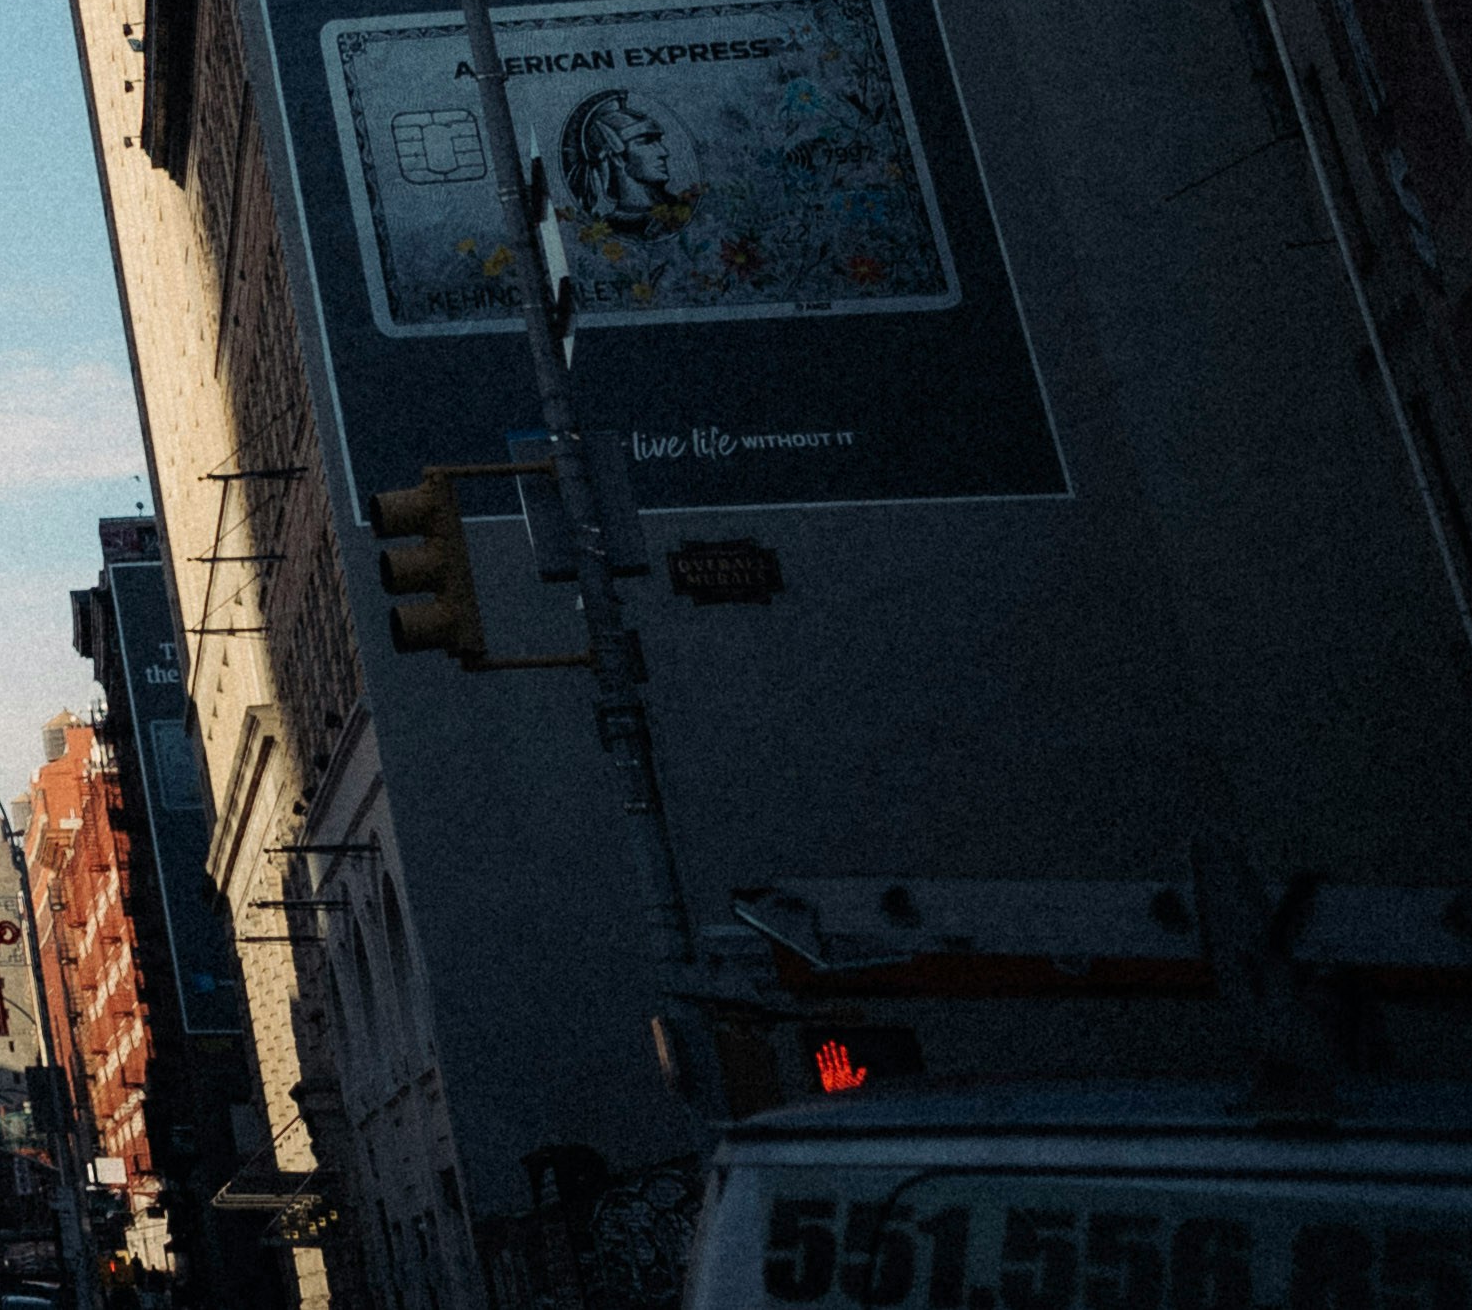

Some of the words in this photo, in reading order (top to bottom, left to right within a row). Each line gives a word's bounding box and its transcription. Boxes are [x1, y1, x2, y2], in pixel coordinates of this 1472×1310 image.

[454, 48, 615, 80] AERICAN
[623, 38, 770, 70] EXPRESS
[632, 430, 686, 462] live
[691, 426, 738, 460] life
[741, 432, 831, 449] WITHOUT
[836, 431, 855, 446] IT
